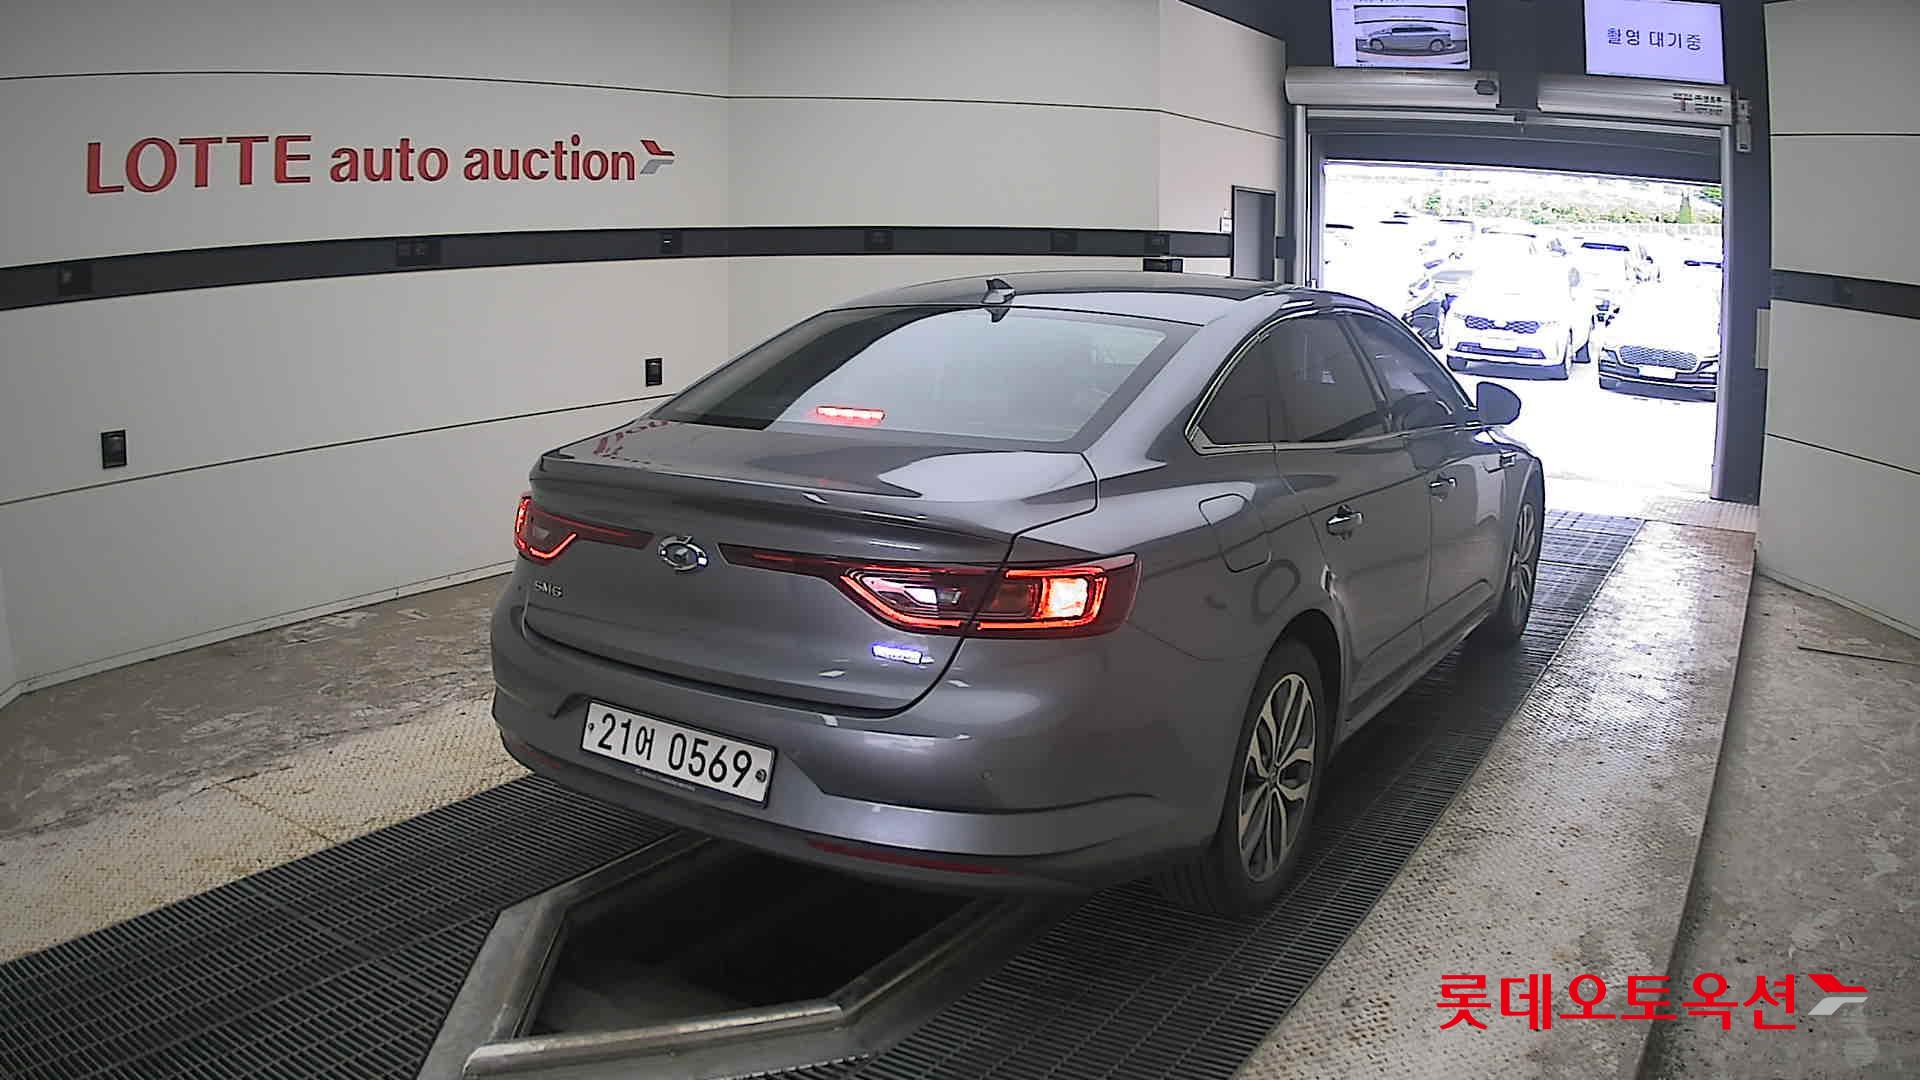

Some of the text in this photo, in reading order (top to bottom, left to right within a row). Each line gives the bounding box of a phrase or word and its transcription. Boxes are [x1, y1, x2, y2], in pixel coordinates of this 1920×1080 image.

[1649, 31, 1701, 51] 대기중
[86, 134, 636, 194] LOTTE auto auction
[535, 580, 563, 598] SM6
[598, 713, 656, 761] 21어
[668, 733, 753, 788] 0569
